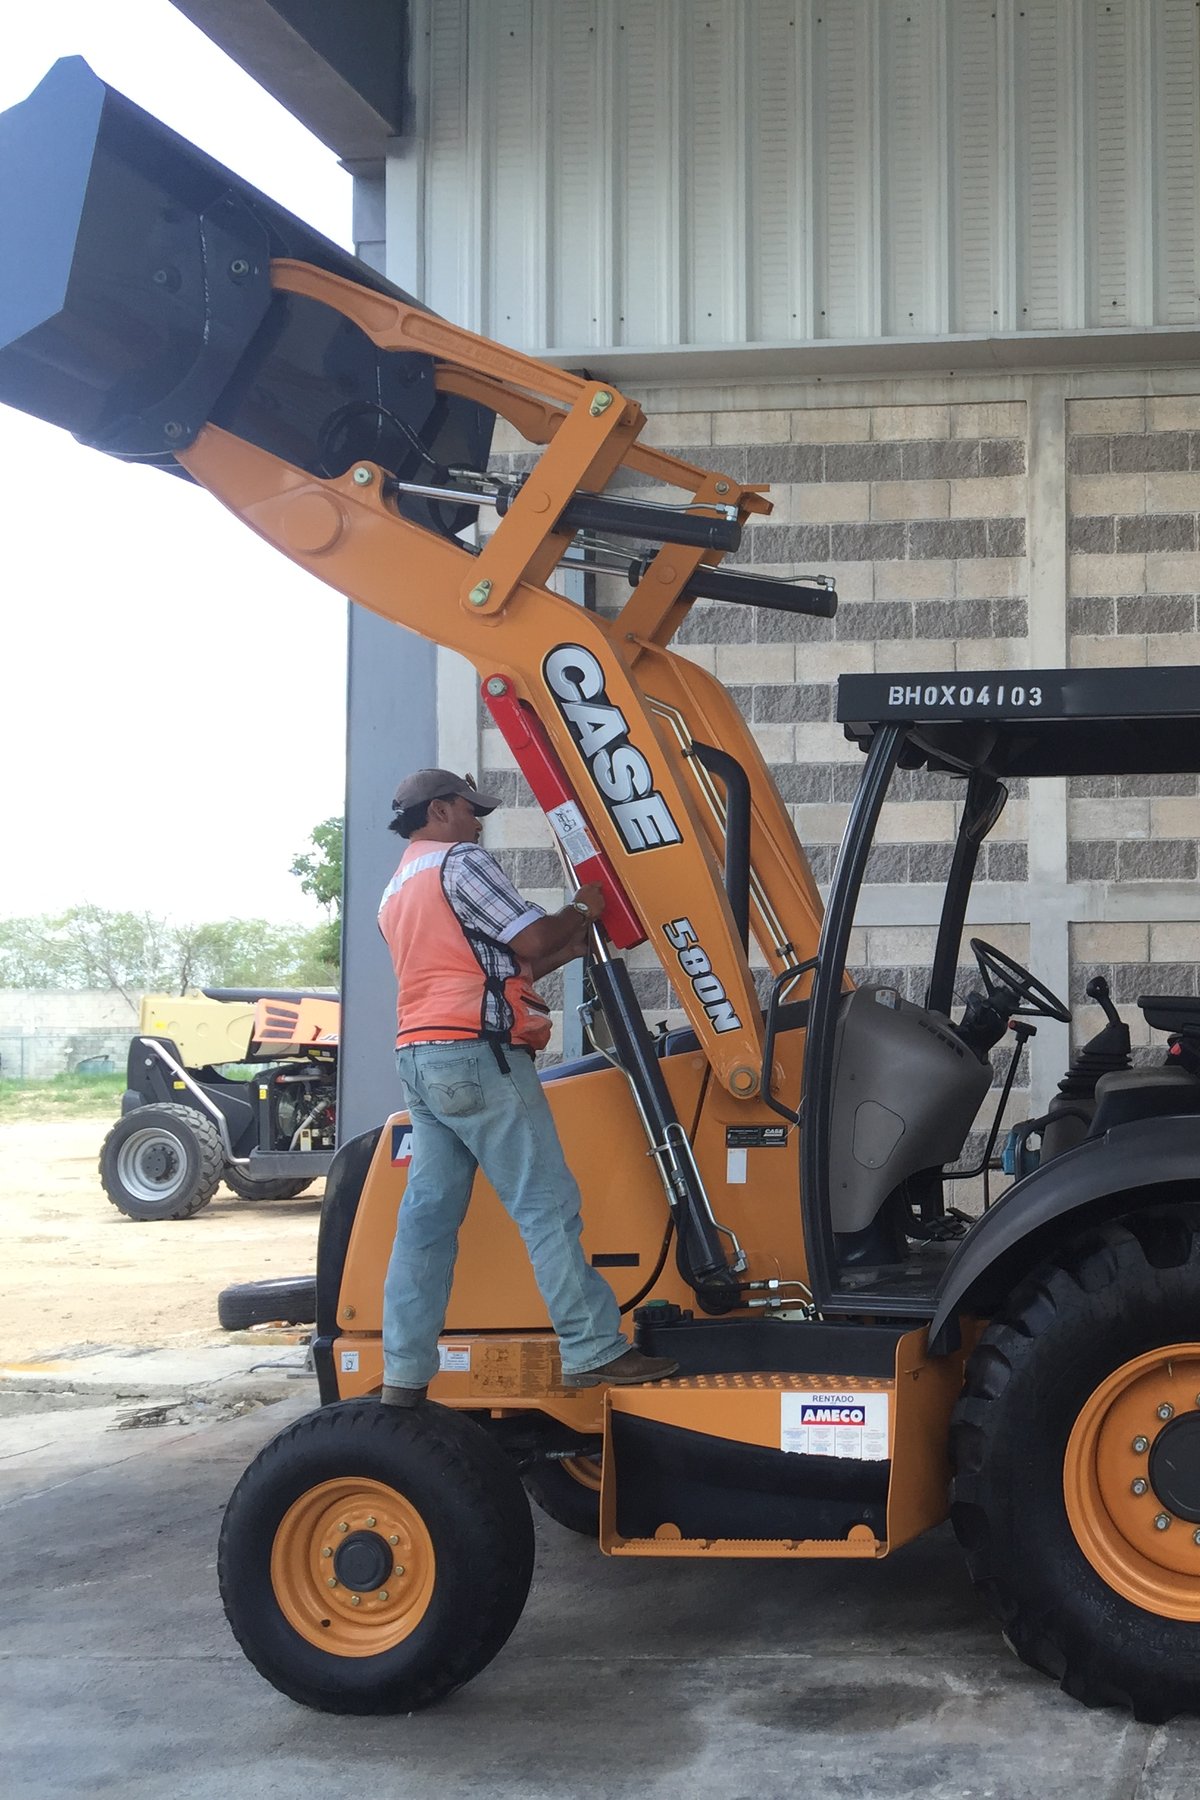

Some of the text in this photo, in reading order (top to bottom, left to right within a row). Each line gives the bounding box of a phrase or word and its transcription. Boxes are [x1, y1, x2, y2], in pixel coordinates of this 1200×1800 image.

[544, 646, 682, 851] CASE
[662, 917, 743, 1034] 580N
[803, 1409, 863, 1423] AMECO
[812, 1395, 855, 1403] RENTADO
